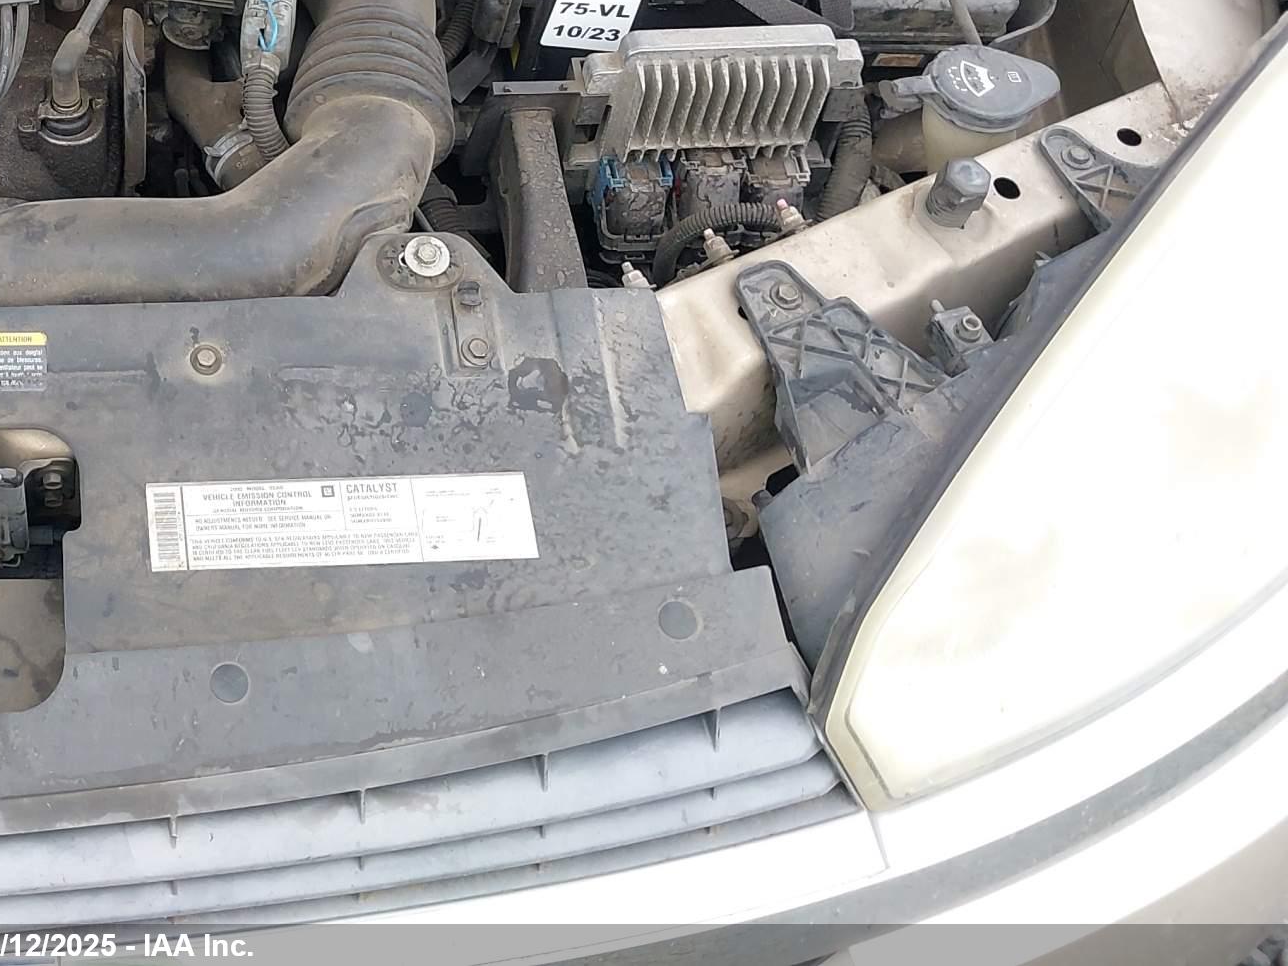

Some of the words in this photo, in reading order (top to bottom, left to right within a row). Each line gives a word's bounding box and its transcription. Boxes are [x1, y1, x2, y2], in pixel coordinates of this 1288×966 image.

[560, 2, 630, 18] 75-VL
[553, 25, 621, 42] 10/23
[346, 482, 398, 494] CATALYST
[237, 492, 274, 500] EMISSION
[277, 490, 312, 498] CONTROL
[233, 499, 286, 507] INFORMATION
